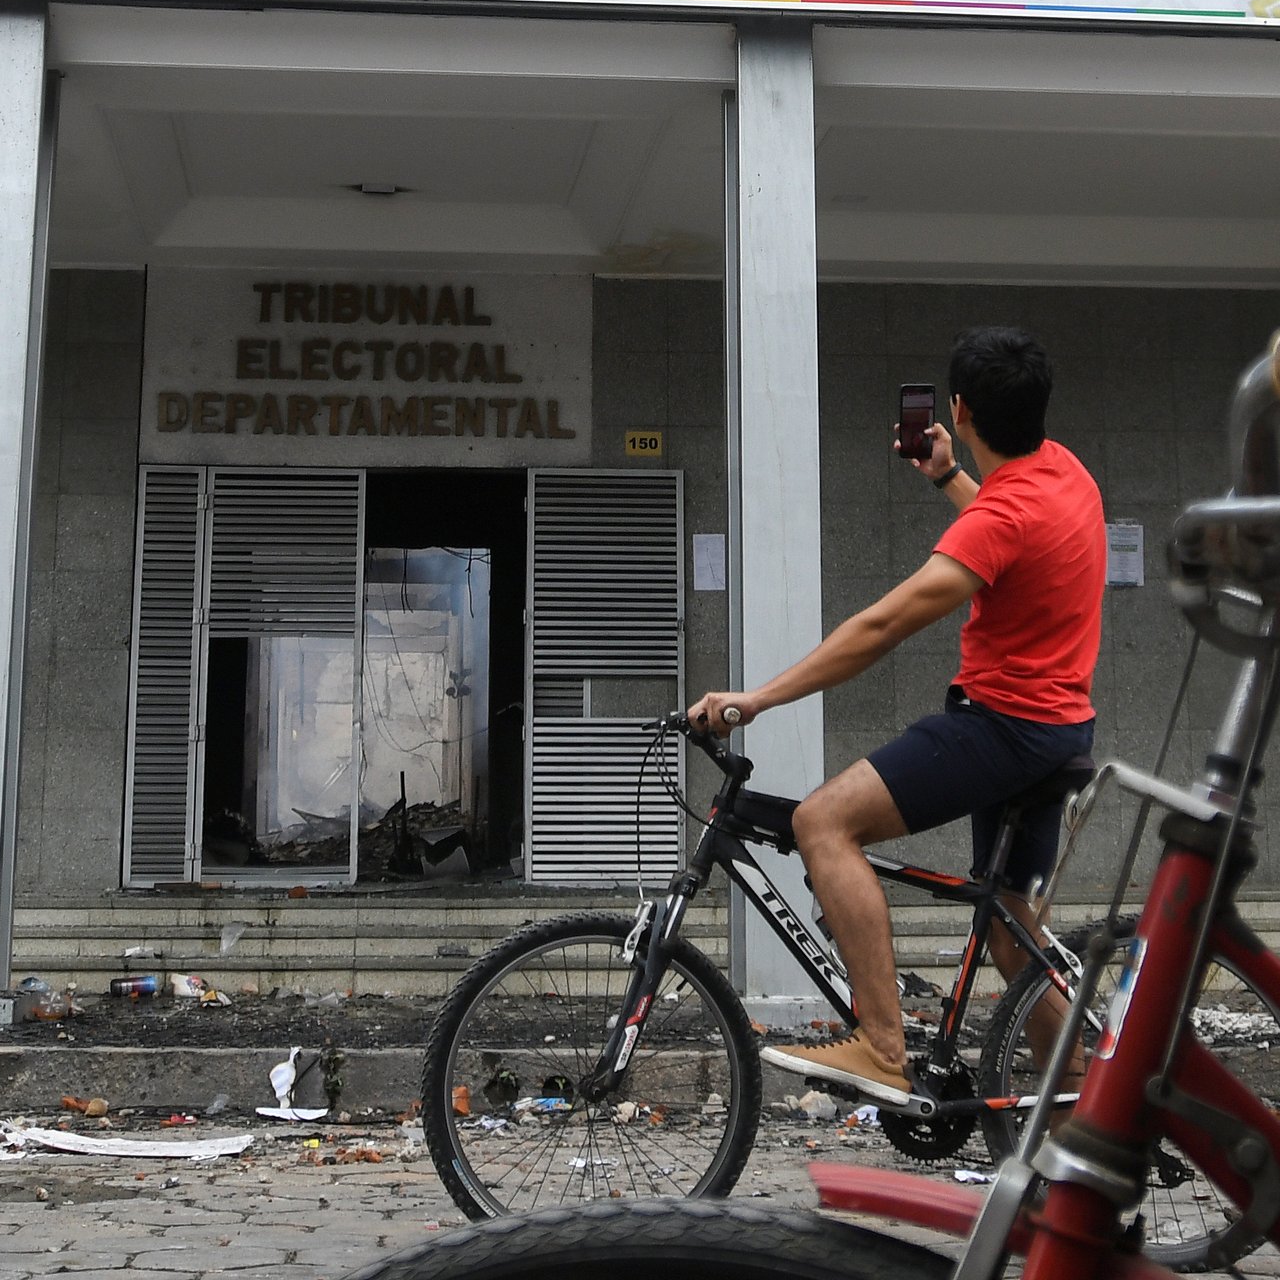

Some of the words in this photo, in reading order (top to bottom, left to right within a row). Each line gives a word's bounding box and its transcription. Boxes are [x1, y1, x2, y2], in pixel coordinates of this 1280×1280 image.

[252, 282, 492, 326] TRIBUNAL
[236, 338, 523, 384] ELECTORAL
[157, 391, 577, 439] DEPARTAMENTAL
[628, 437, 659, 450] 150
[761, 882, 839, 983] TREK
